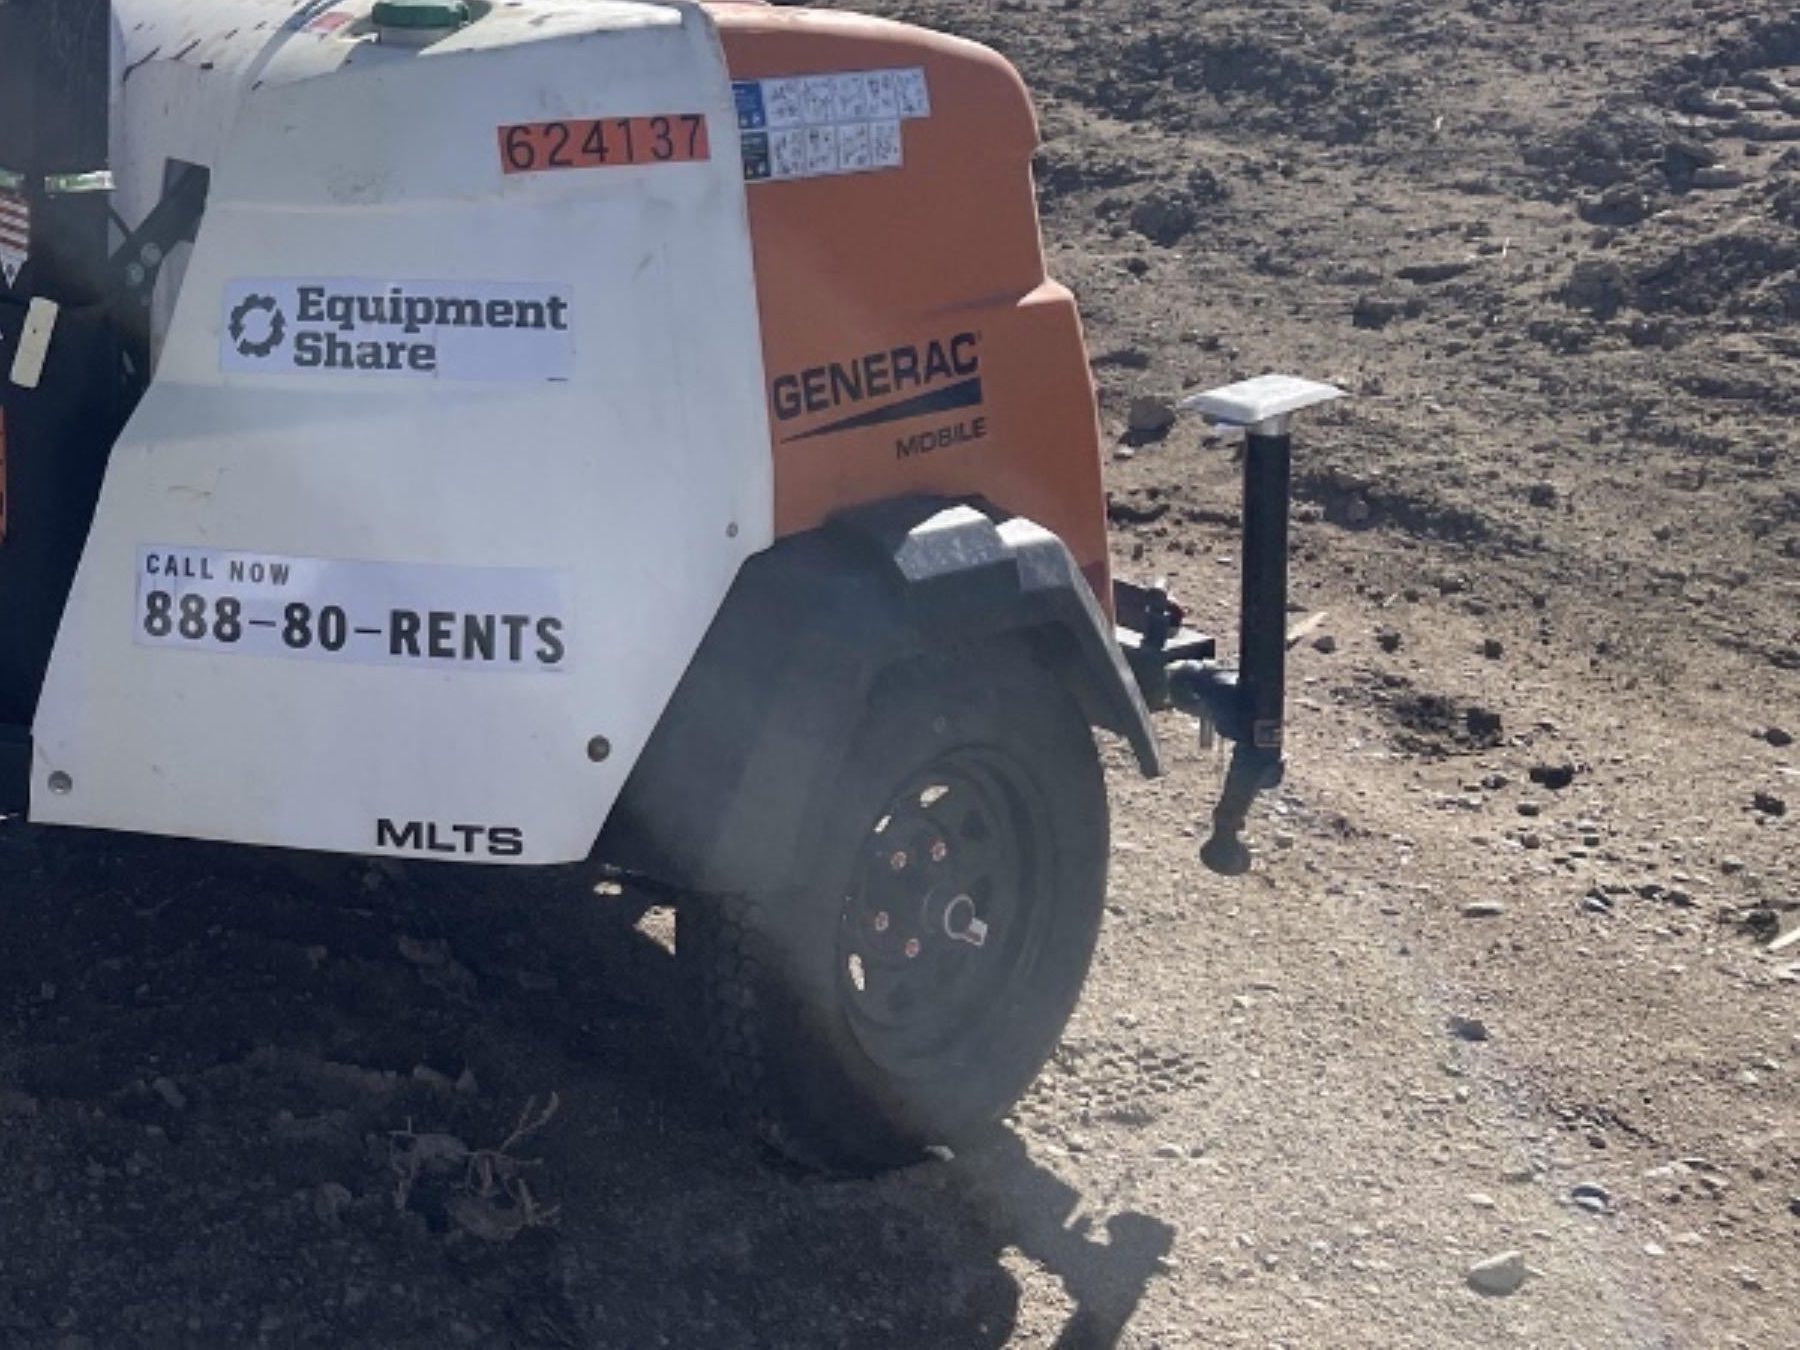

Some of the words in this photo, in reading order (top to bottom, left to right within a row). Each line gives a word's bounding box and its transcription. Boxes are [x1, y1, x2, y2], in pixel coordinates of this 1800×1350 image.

[506, 114, 700, 170] 624137
[296, 286, 568, 334] Equipment
[294, 331, 436, 370] Share
[772, 331, 981, 421] GENERAC
[895, 416, 988, 460] MOBILE
[146, 554, 214, 581] CALL
[229, 561, 290, 586] NOW
[143, 590, 566, 665] 888-80-RENTS
[377, 818, 523, 856] MLTS
